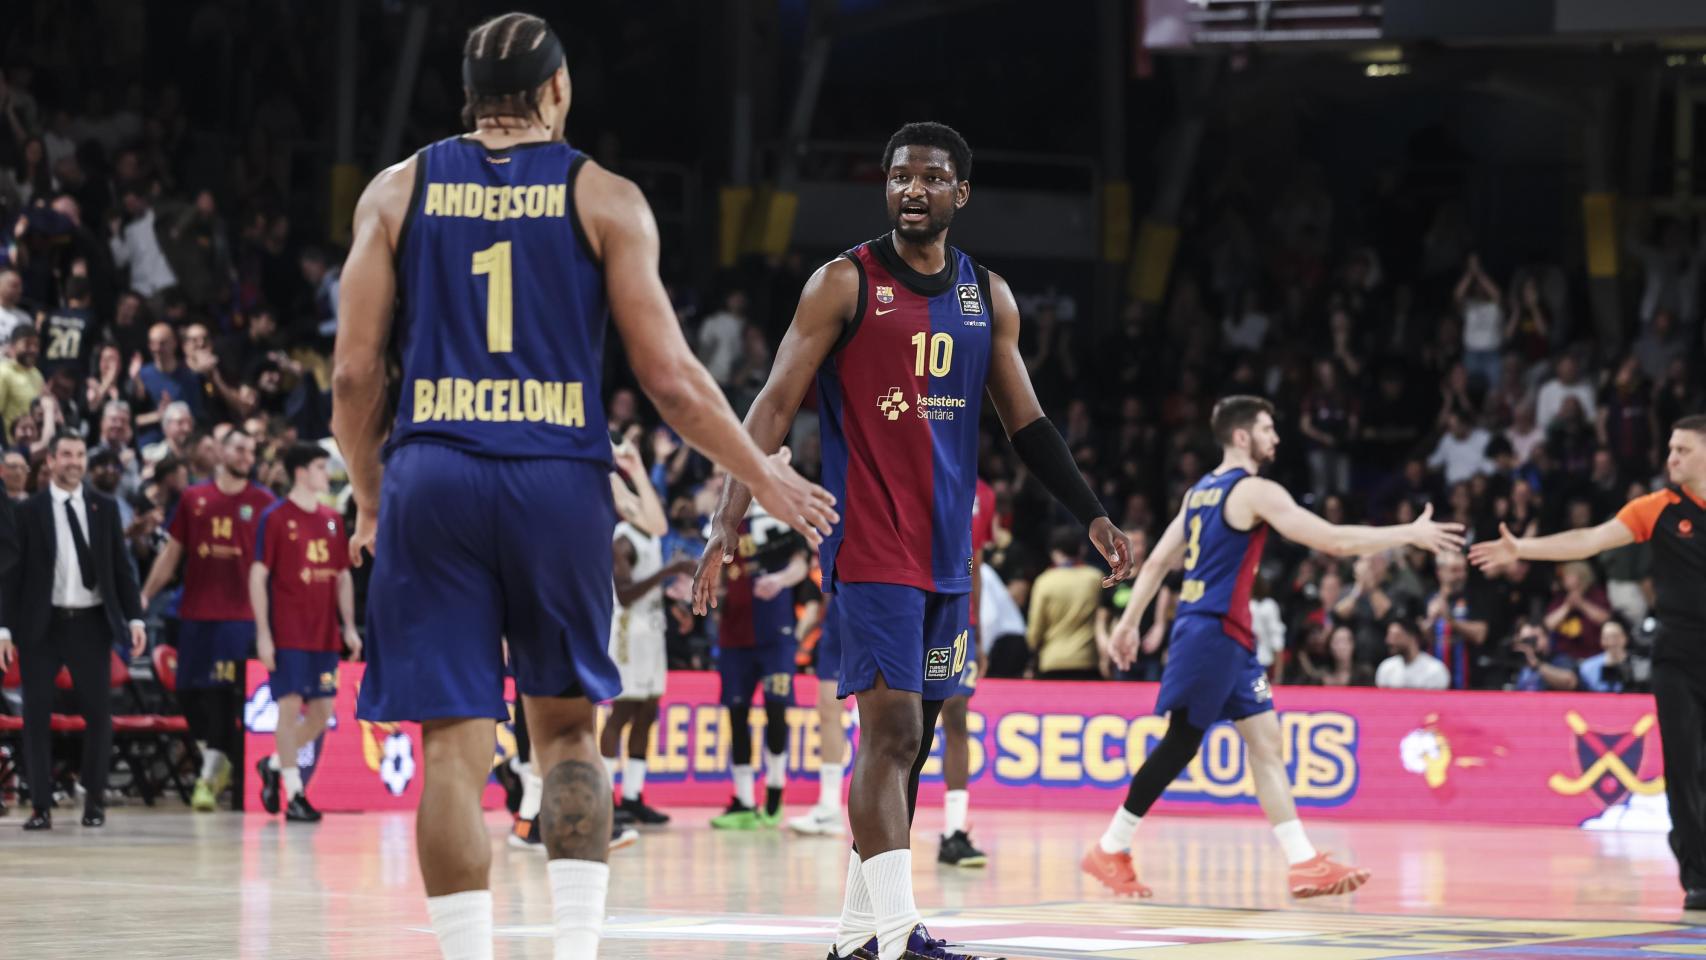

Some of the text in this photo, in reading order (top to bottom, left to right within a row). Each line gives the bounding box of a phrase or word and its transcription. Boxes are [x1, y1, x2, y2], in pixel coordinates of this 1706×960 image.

[424, 182, 567, 221] ANDERSON
[471, 240, 514, 354] 1
[959, 286, 978, 299] 25
[911, 331, 954, 378] 10
[412, 377, 586, 429] BARCELONA
[929, 650, 949, 664] 25
[951, 629, 968, 677] 10
